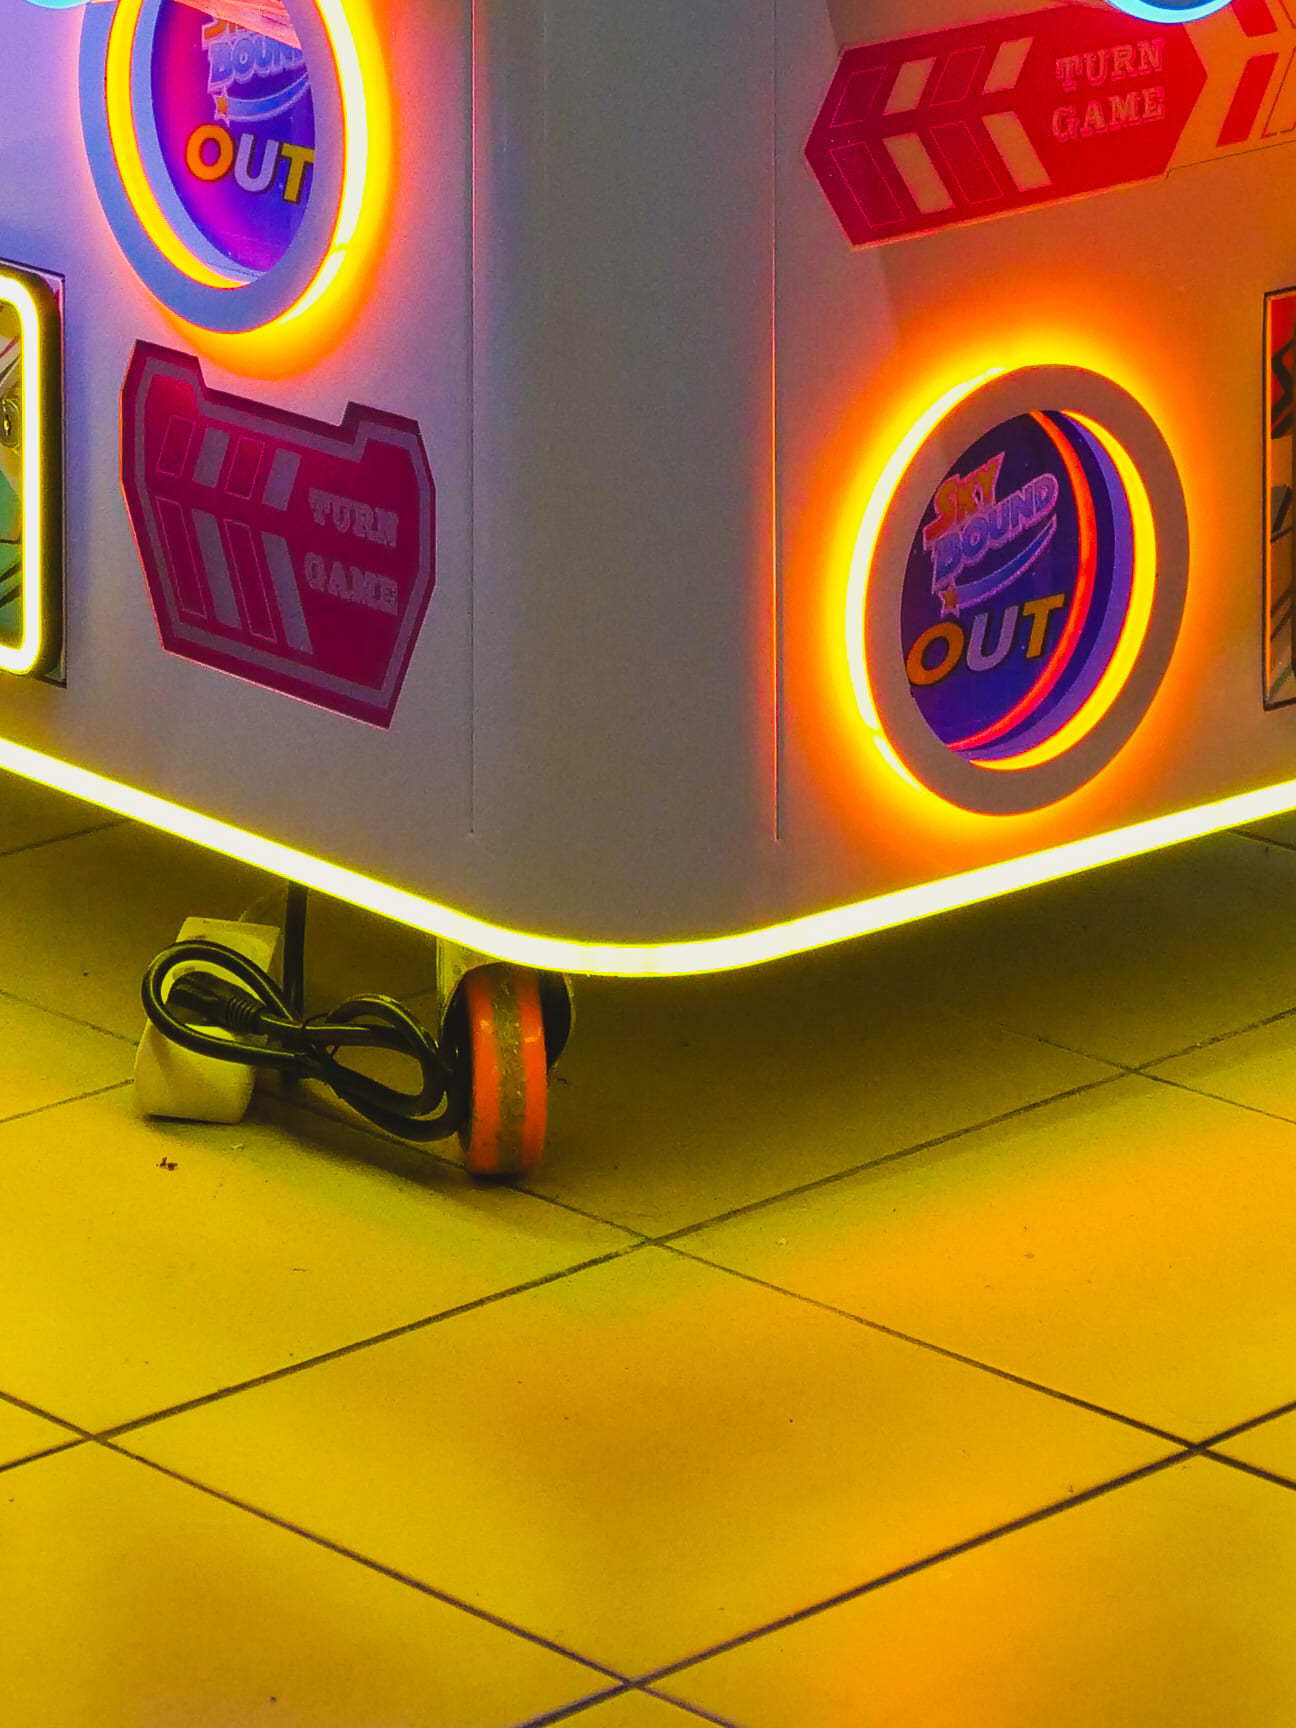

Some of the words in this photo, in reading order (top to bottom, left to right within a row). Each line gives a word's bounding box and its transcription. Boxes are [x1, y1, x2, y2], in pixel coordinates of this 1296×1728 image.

[1055, 37, 1165, 92] TURN
[1052, 85, 1165, 143] GAME
[186, 123, 315, 204] OUT
[308, 487, 399, 550] TURN
[924, 458, 1003, 542] SKY
[933, 473, 1059, 587] BOUND
[304, 551, 398, 616] GAME
[906, 594, 1065, 686] OUT
